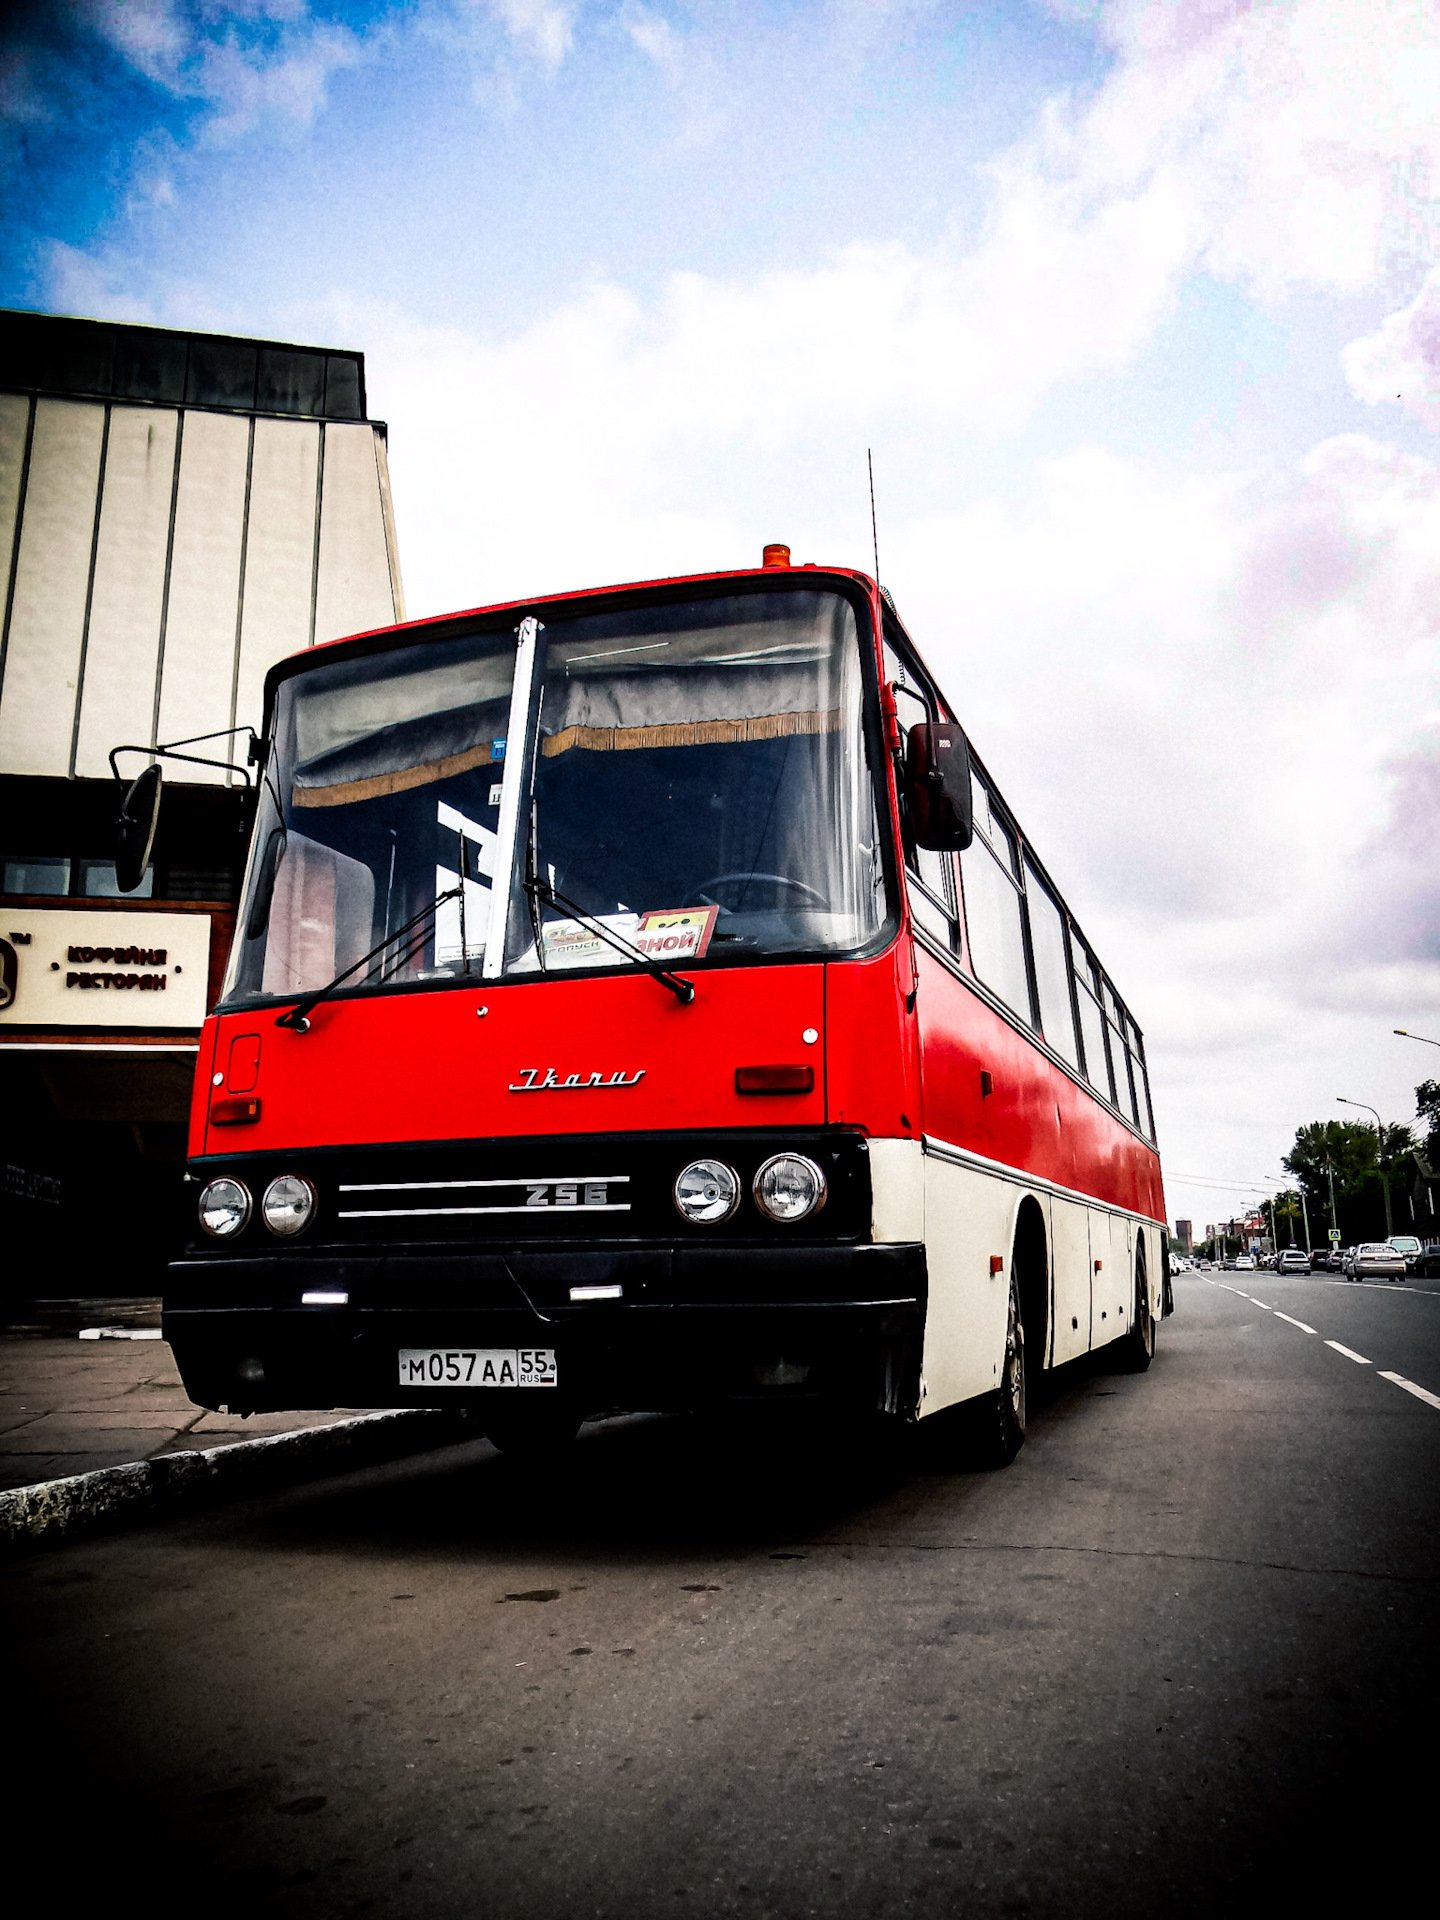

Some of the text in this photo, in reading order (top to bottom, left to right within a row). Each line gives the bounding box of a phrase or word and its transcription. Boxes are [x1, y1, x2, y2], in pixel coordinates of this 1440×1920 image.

[67, 945, 168, 966] КОФЕЙНЯ
[66, 971, 167, 990] РЕСТОРАН
[508, 1067, 646, 1091] Ikarus
[520, 1351, 548, 1373] 55
[520, 1374, 540, 1383] RUS
